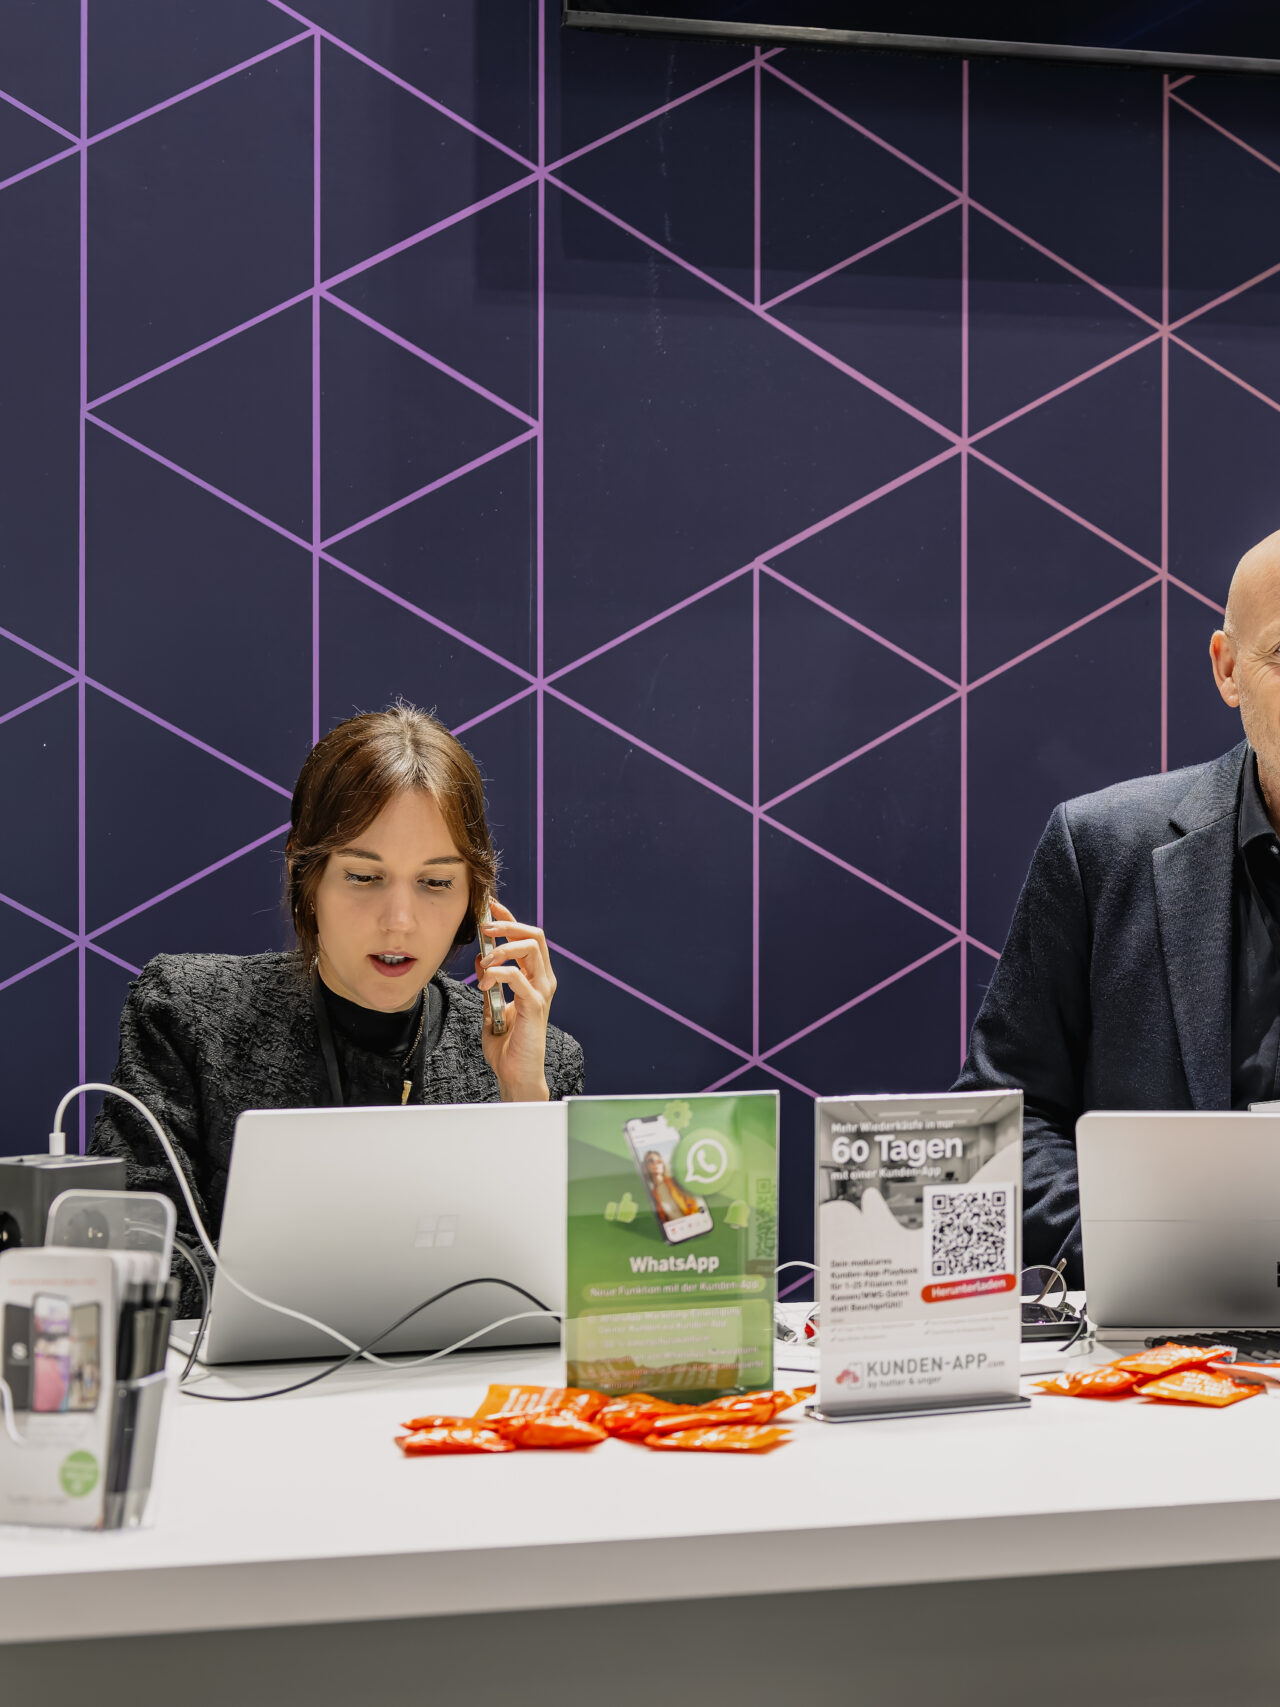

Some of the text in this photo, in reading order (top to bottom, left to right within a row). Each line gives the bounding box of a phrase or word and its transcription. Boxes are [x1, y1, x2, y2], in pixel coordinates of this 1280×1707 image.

[831, 1120, 954, 1133] Mehr Wiederkäufe in nur
[832, 1134, 963, 1167] 60 Tagen
[831, 1166, 941, 1181] mit einer Kunden-App
[629, 1254, 720, 1273] WhatsApp
[831, 1258, 892, 1268] Dein modulares
[590, 1279, 759, 1298] Neue Funktion mit der Kunden-App
[864, 1280, 892, 1288] Filialen
[931, 1279, 1007, 1298] Herunterladen
[867, 1380, 877, 1389] by
[880, 1378, 906, 1387] hutter
[917, 1376, 942, 1385] unger
